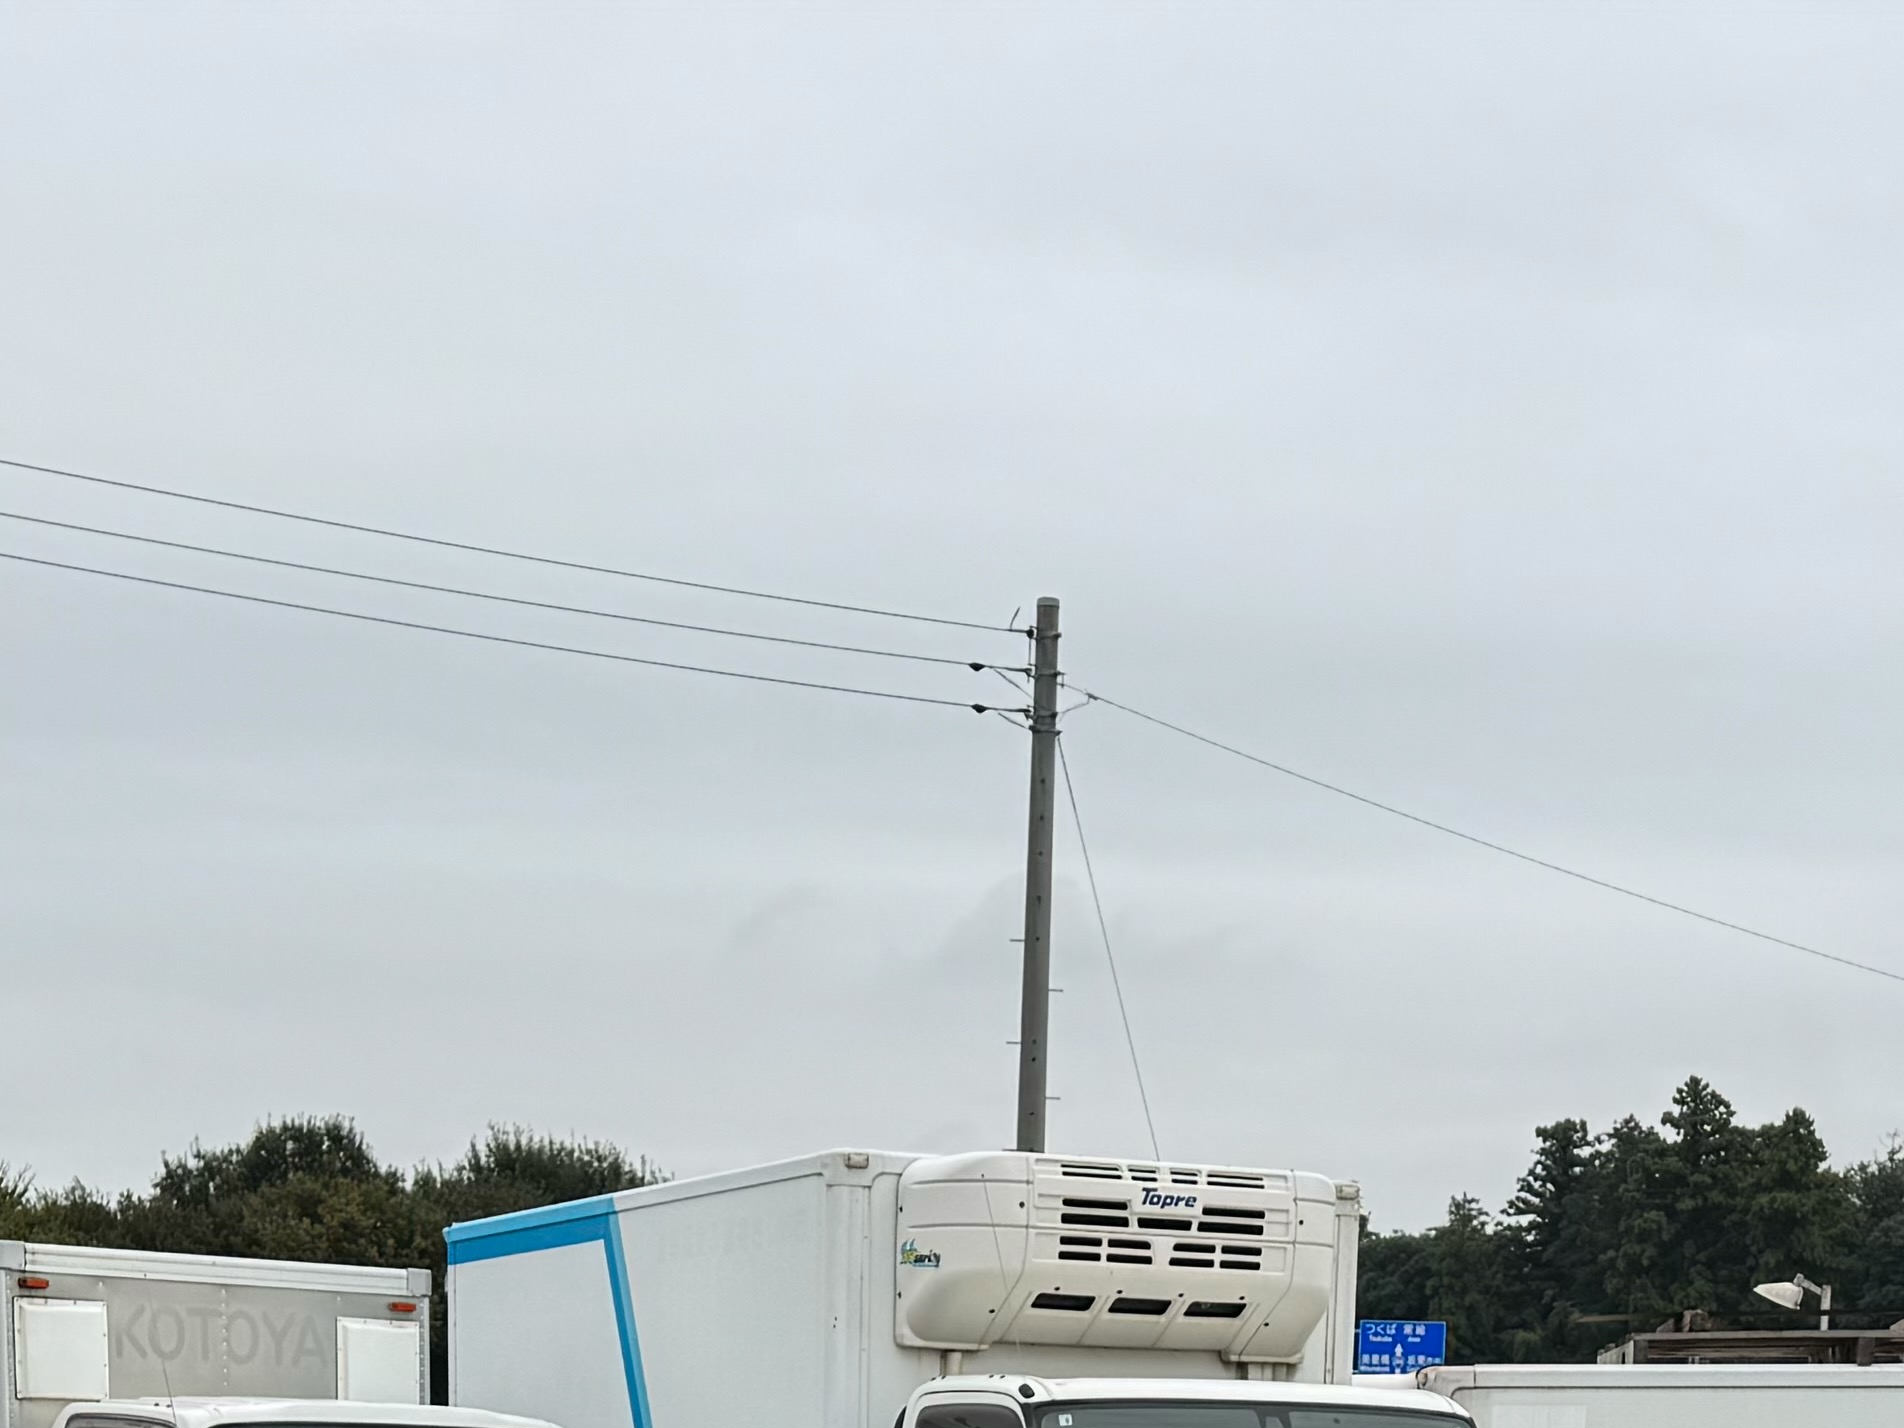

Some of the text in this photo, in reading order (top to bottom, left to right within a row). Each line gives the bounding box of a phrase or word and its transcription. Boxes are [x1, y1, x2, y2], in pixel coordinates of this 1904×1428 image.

[1141, 1186, 1198, 1209] Topre
[114, 1303, 328, 1369] KOTOYA
[1365, 1323, 1397, 1335] つくば
